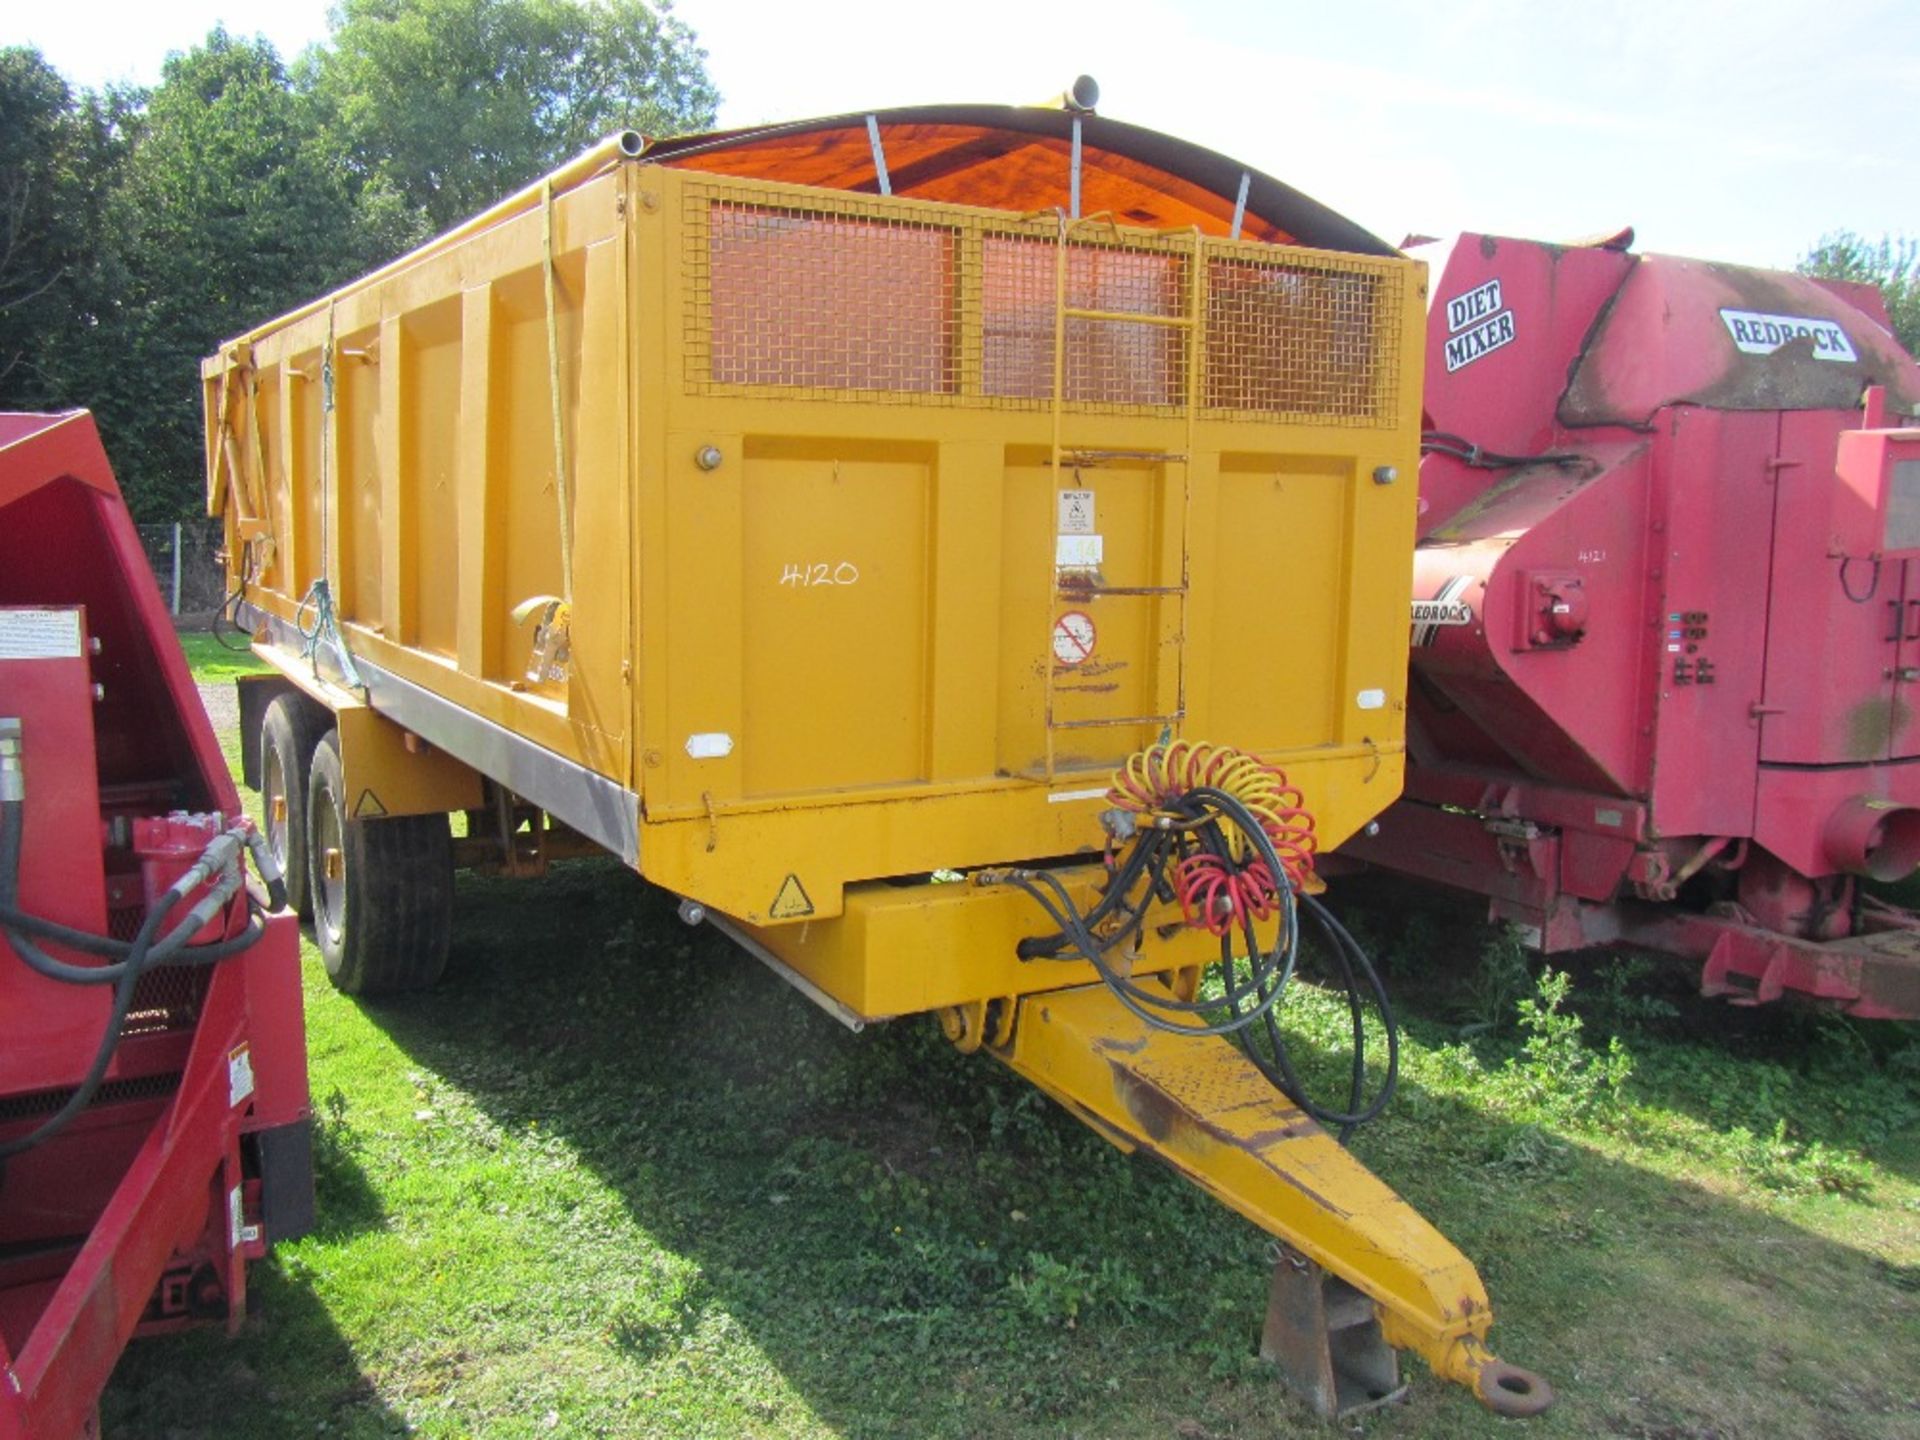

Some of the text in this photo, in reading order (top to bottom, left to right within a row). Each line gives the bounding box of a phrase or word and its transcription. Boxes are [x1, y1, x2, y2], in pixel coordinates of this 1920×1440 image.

[1451, 282, 1499, 329] DIET
[1447, 314, 1513, 369] MIXER
[1731, 318, 1847, 352] REDROCK
[779, 562, 859, 587] 4120
[1411, 603, 1472, 621] EDROCK
